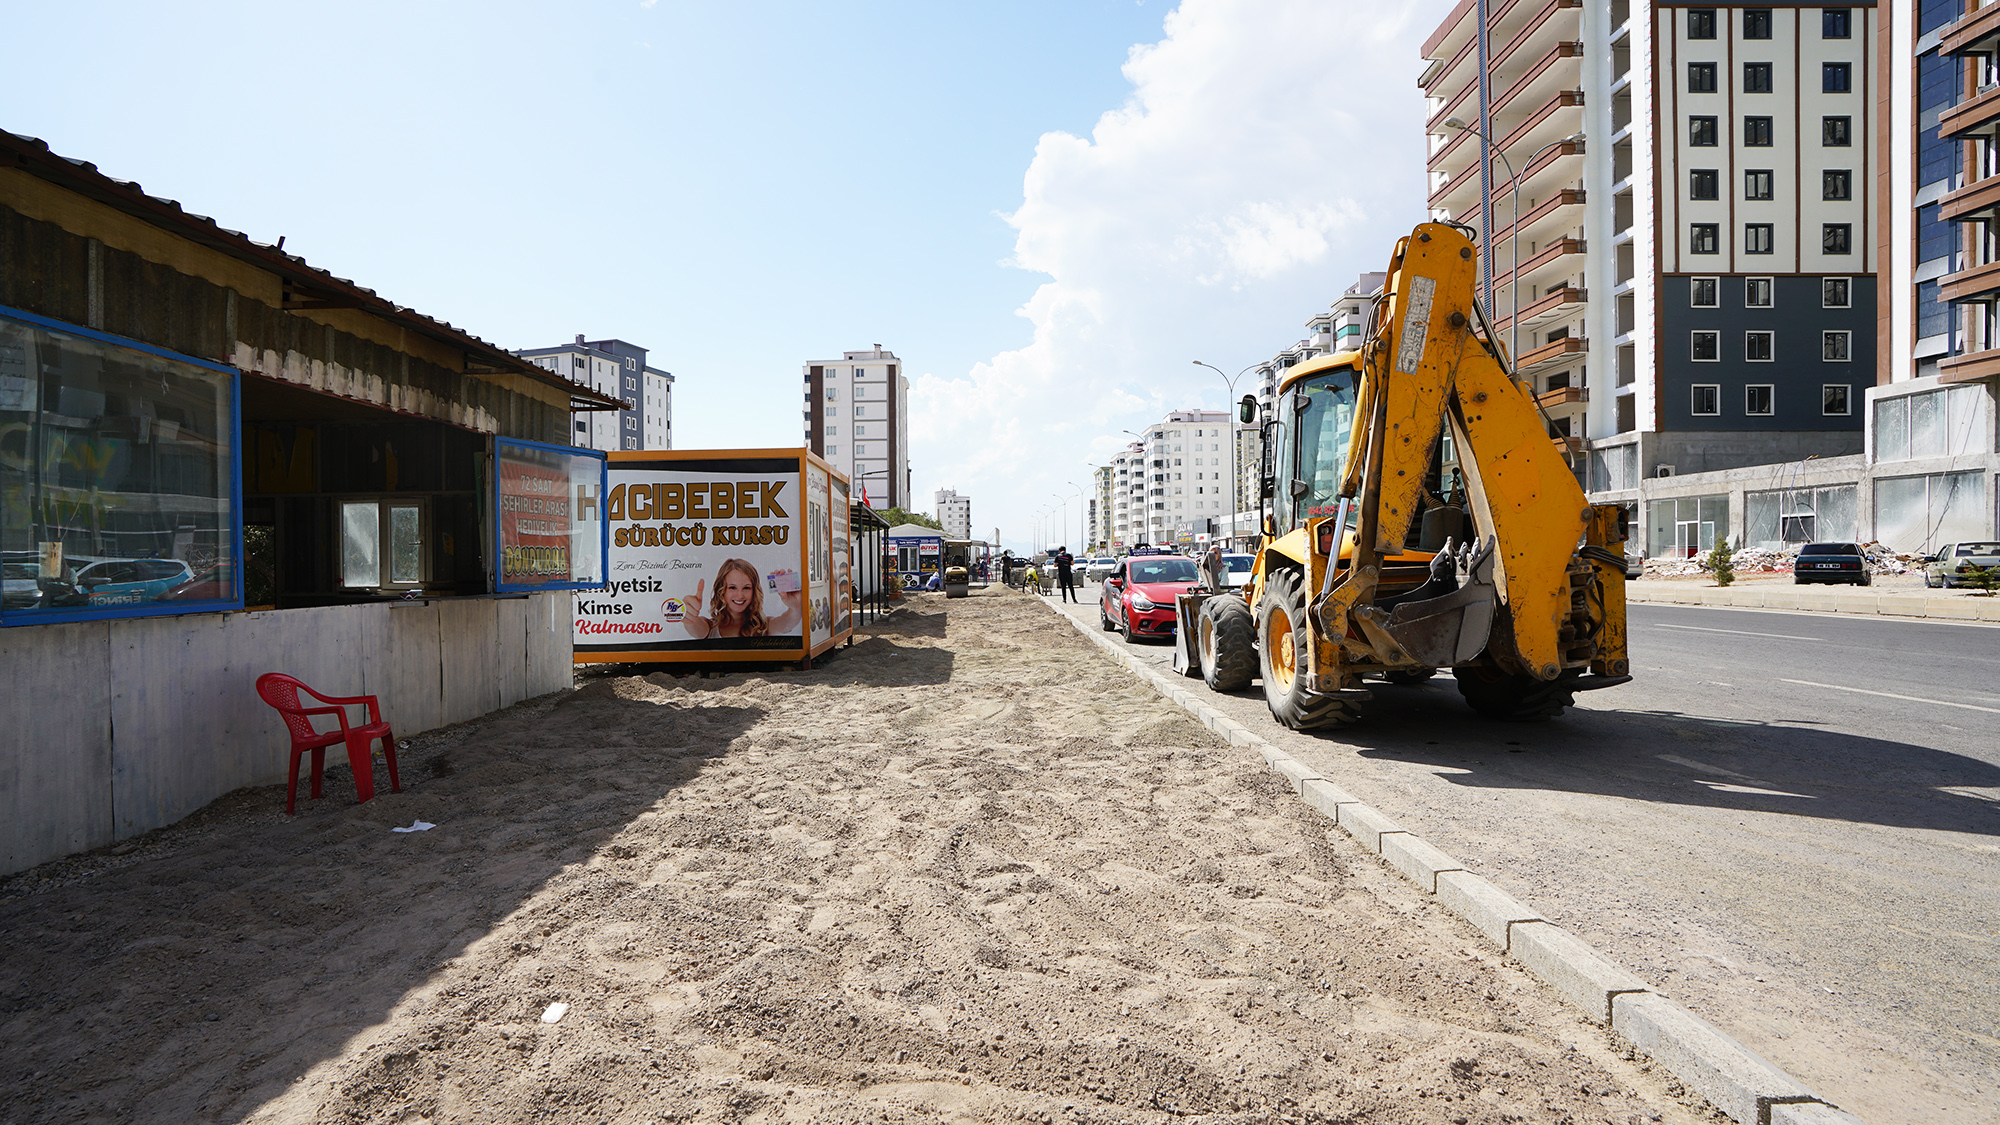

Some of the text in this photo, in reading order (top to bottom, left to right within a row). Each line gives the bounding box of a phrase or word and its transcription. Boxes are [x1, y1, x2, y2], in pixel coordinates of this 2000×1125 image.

[520, 474, 553, 495] 72 SAAT
[503, 493, 567, 517] ŞEHİRLER ARASI
[1308, 506, 1323, 515] 0542
[1324, 505, 1336, 514] 825
[516, 515, 558, 536] HEDİYELİK
[614, 522, 789, 547] SÜRÜCÜ KURSU
[505, 544, 568, 577] DONDURMA
[578, 600, 633, 615] Kimse
[575, 619, 663, 635] Kalmasın
